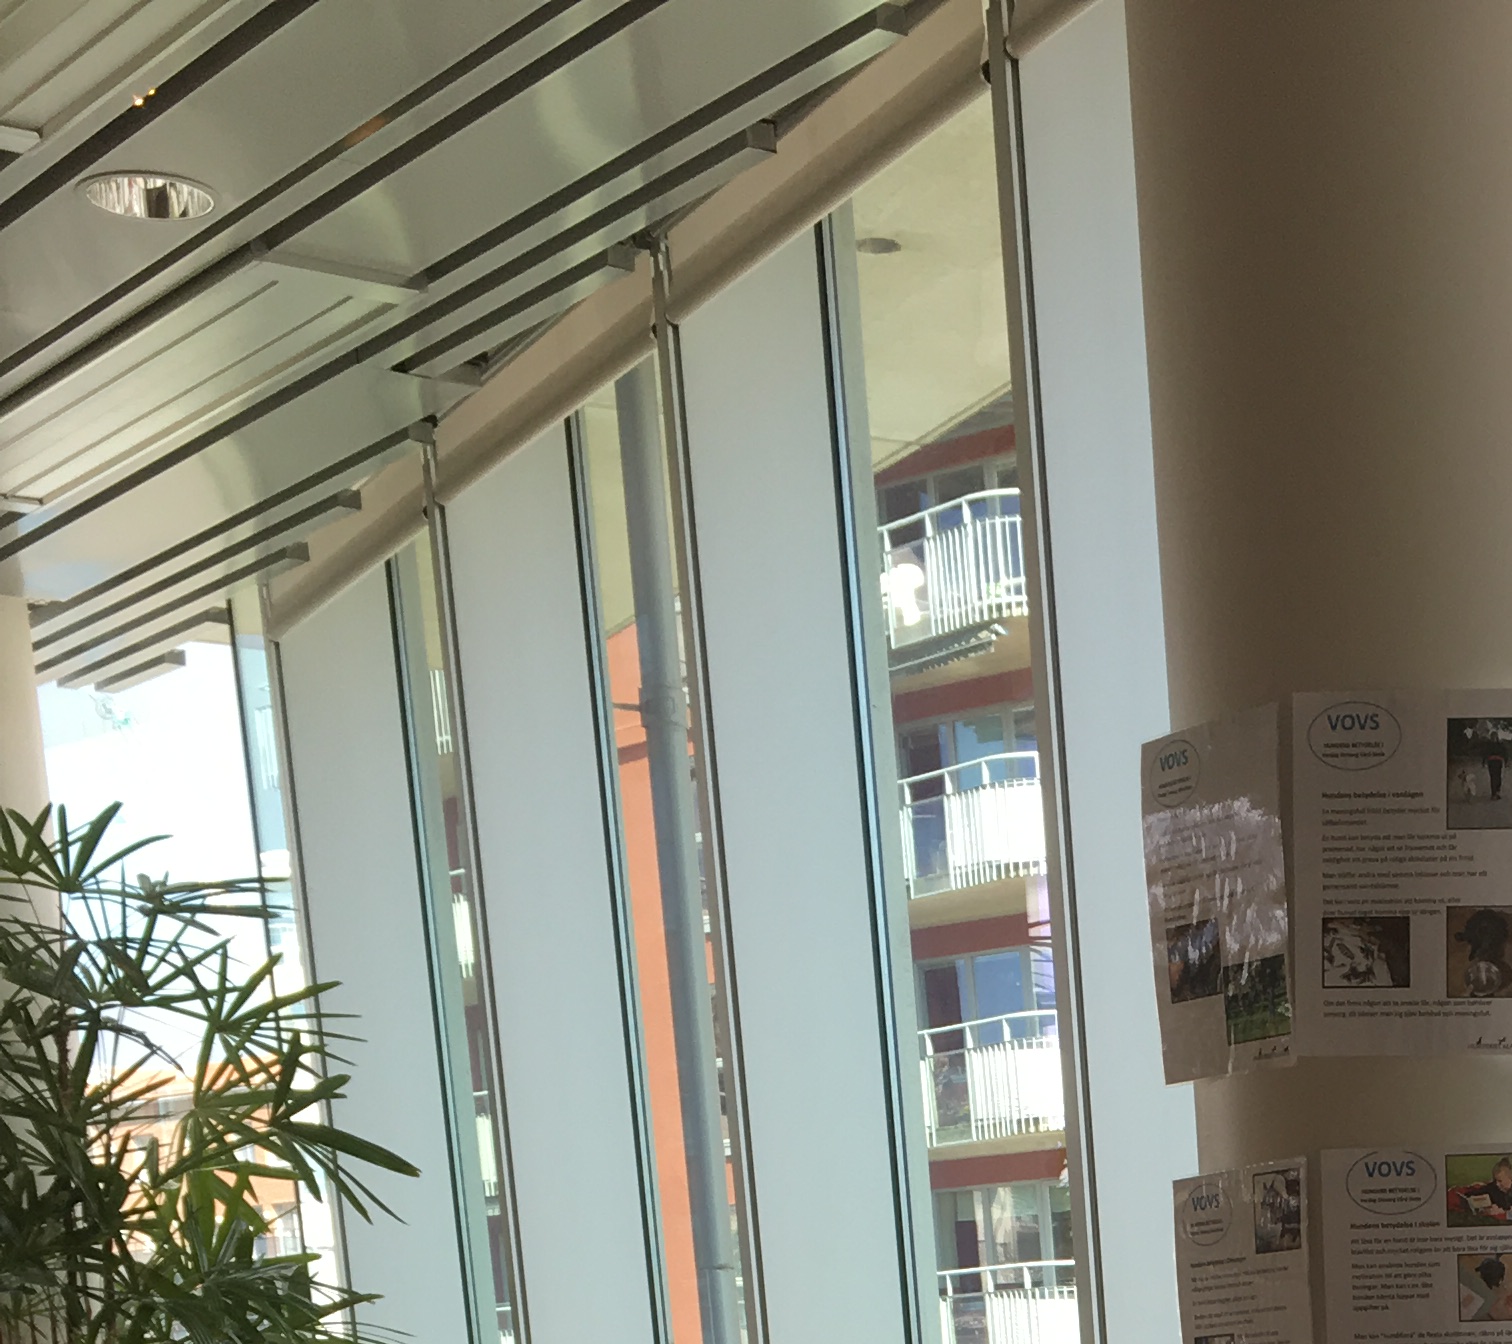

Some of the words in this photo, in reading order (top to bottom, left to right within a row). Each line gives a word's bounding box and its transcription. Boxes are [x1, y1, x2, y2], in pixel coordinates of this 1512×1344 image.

[1327, 713, 1380, 731] VOVS
[1159, 749, 1189, 772] VOVS
[1364, 1160, 1416, 1177] VOVS
[1191, 1193, 1220, 1212] VOVS
